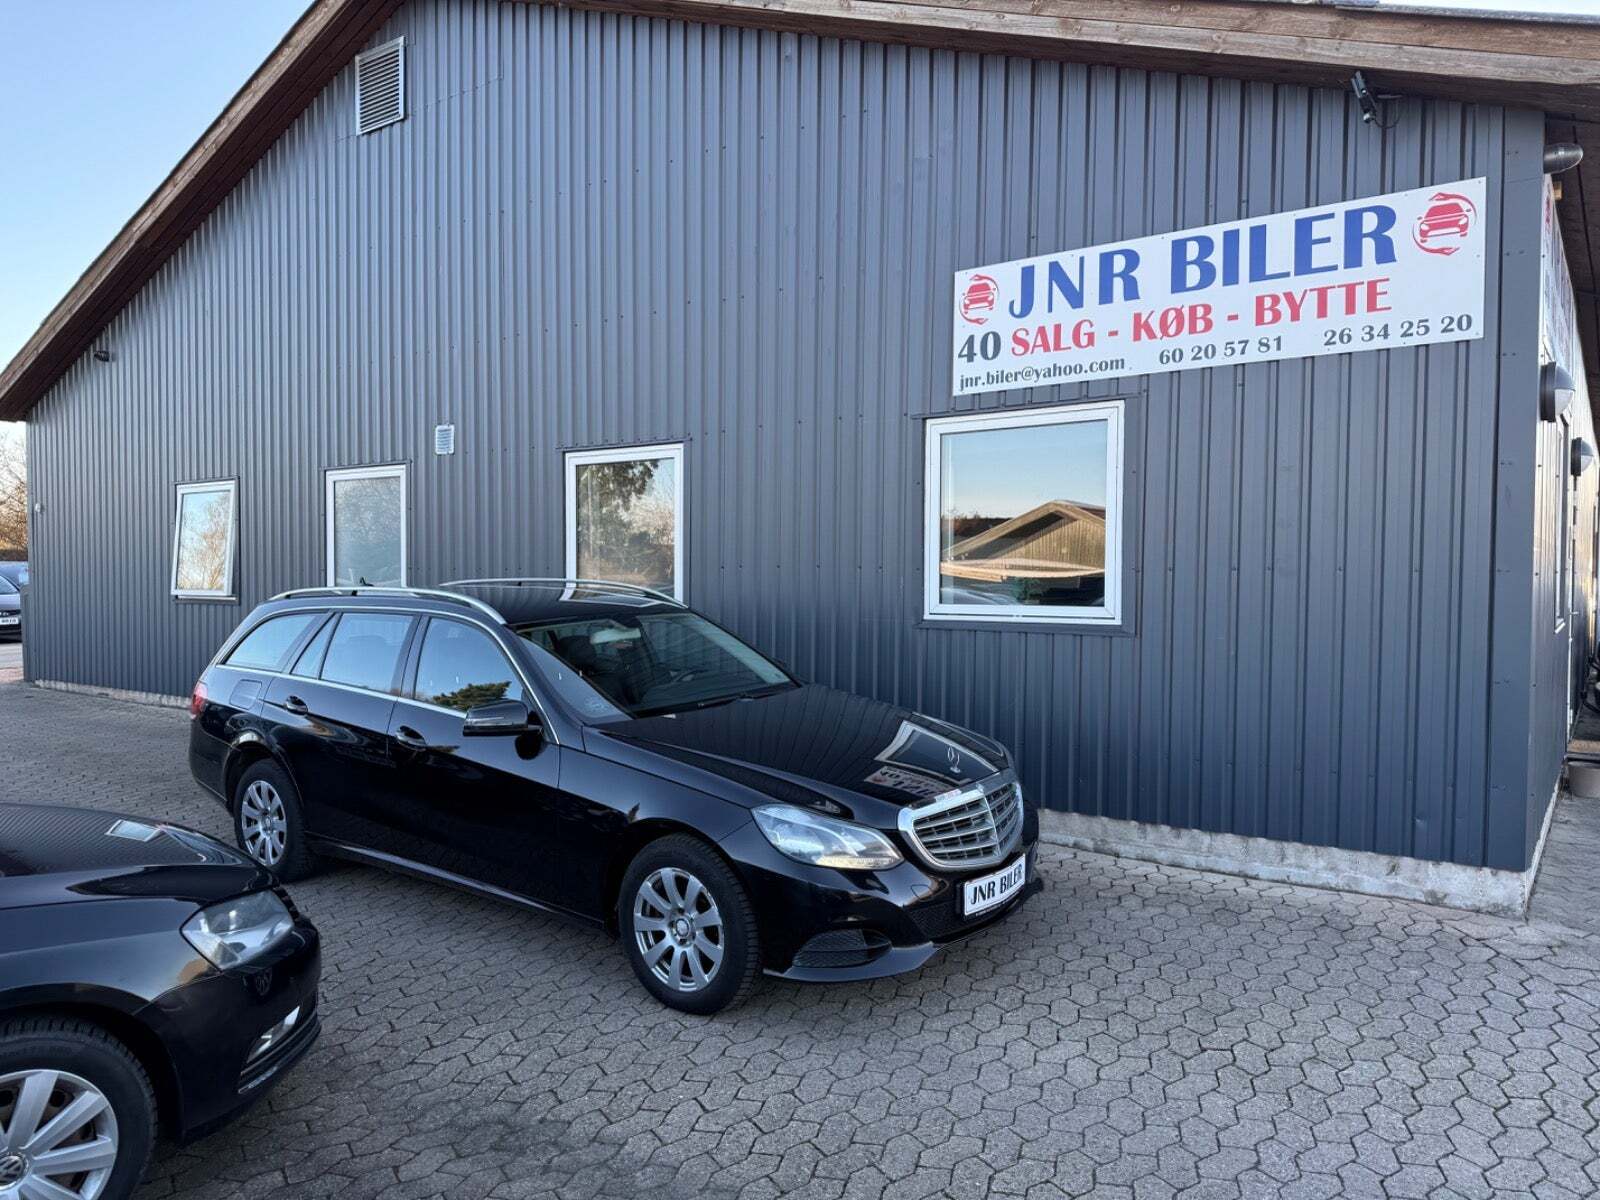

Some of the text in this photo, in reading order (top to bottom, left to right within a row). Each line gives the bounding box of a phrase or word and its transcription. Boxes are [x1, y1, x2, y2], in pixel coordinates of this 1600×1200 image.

[1009, 204, 1398, 320] JNR BILER
[1011, 319, 1096, 357] SALG
[1132, 303, 1214, 342] KØB
[1254, 277, 1393, 327] BYTTE
[1323, 313, 1473, 347] 26 34 25 20
[957, 330, 1002, 364] 40
[1158, 335, 1282, 365] 60 20 57 81
[959, 357, 1125, 392] jnr.biler@yahoo.com
[970, 880, 996, 905] JNR
[999, 863, 1023, 894] BILER
